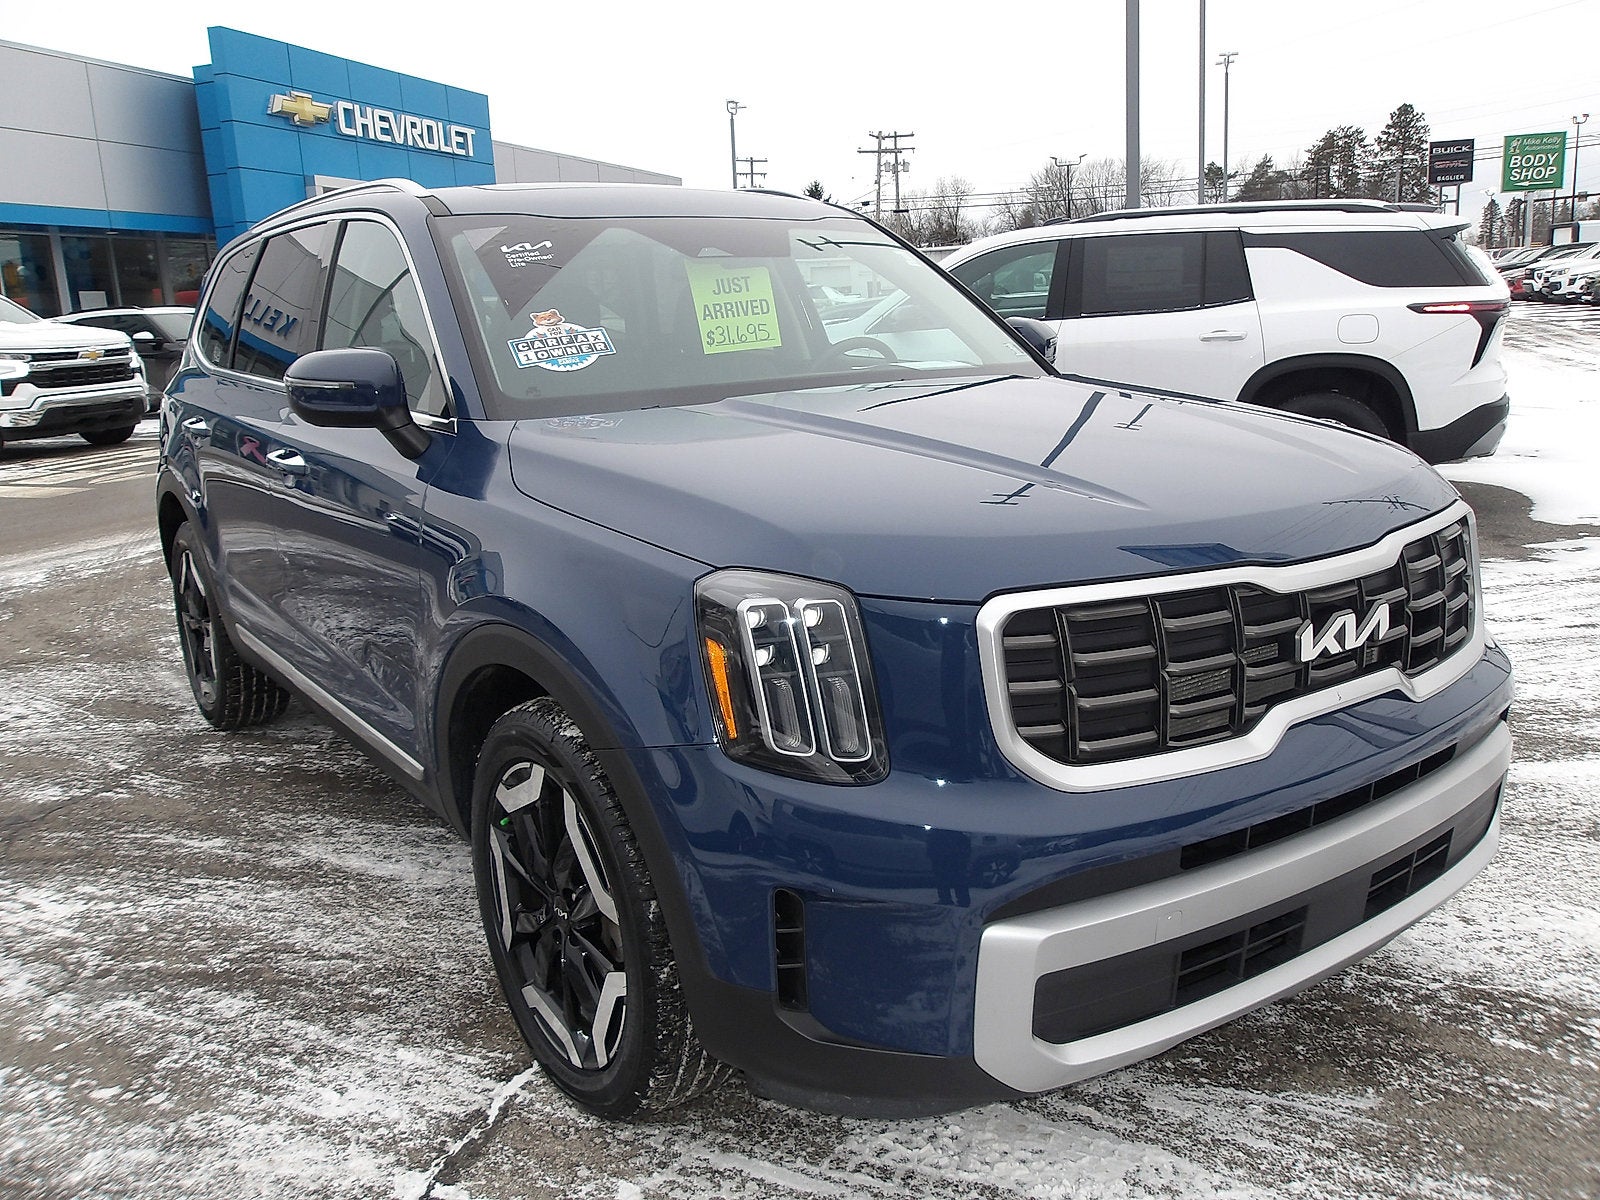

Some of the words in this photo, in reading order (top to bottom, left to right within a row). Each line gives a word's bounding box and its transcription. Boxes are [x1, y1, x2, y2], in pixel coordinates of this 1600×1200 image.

[335, 100, 476, 157] CHEVROLET
[1432, 145, 1471, 154] BUICK
[1509, 152, 1559, 168] BODY
[1510, 166, 1557, 181] SHOP
[712, 276, 751, 295] JUST
[703, 299, 770, 321] ARRIVED
[515, 334, 601, 352] CARFAX
[706, 323, 770, 347] $31,695
[534, 343, 609, 360] OWNER
